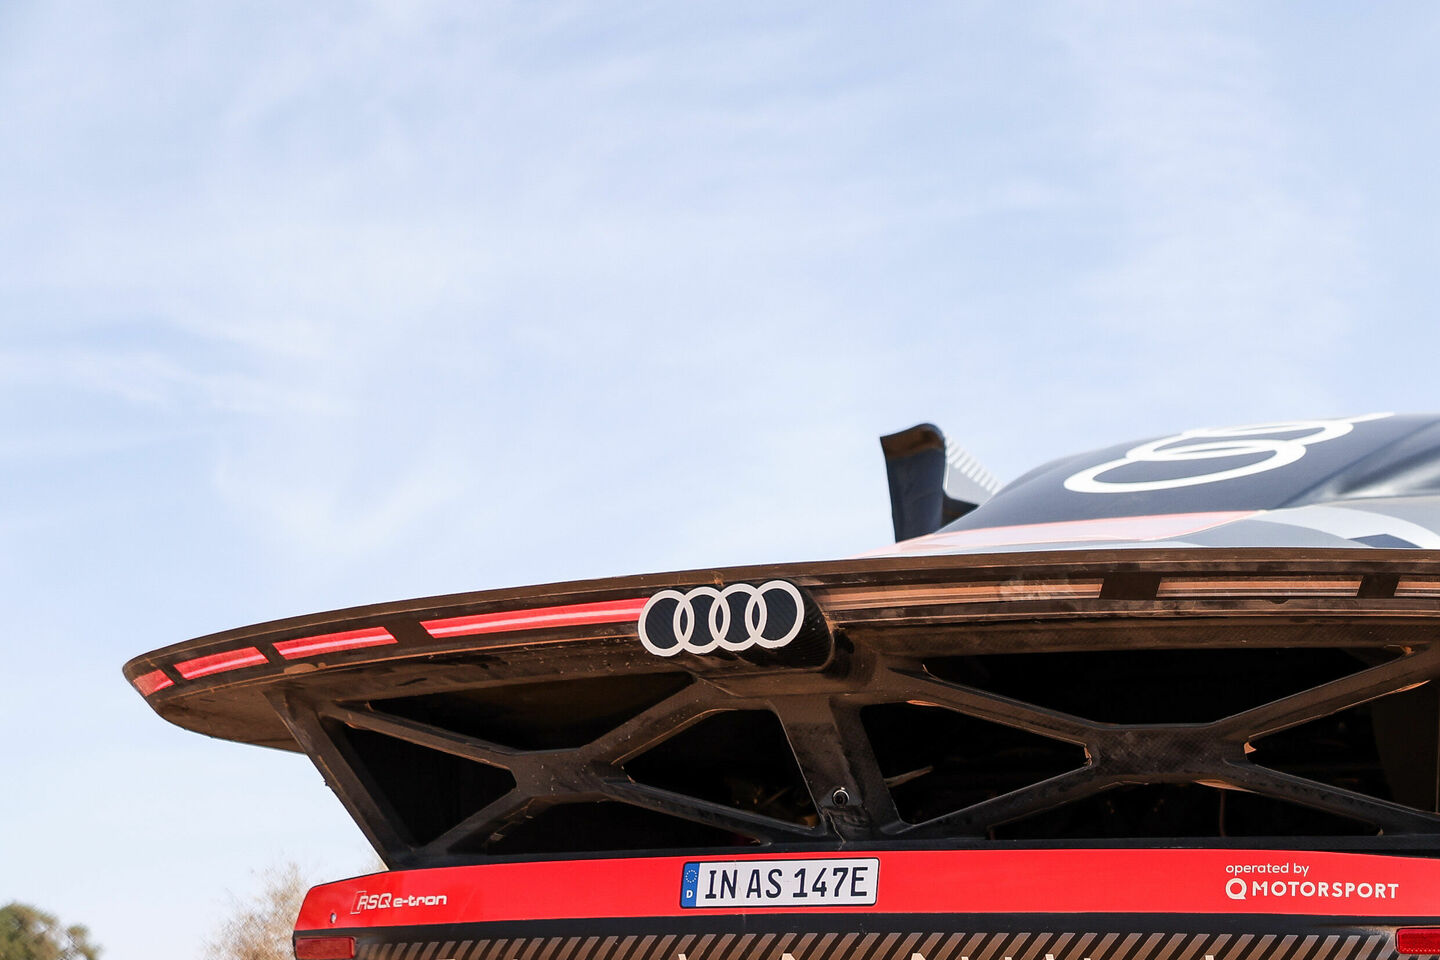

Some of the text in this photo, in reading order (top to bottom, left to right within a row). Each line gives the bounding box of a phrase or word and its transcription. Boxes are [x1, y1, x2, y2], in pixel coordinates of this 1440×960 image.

[1225, 863, 1310, 876] operated by
[704, 867, 869, 899] IN AS 147E
[1252, 881, 1400, 899] MOTORSPORT
[393, 894, 448, 908] e-tron
[685, 889, 694, 899] D
